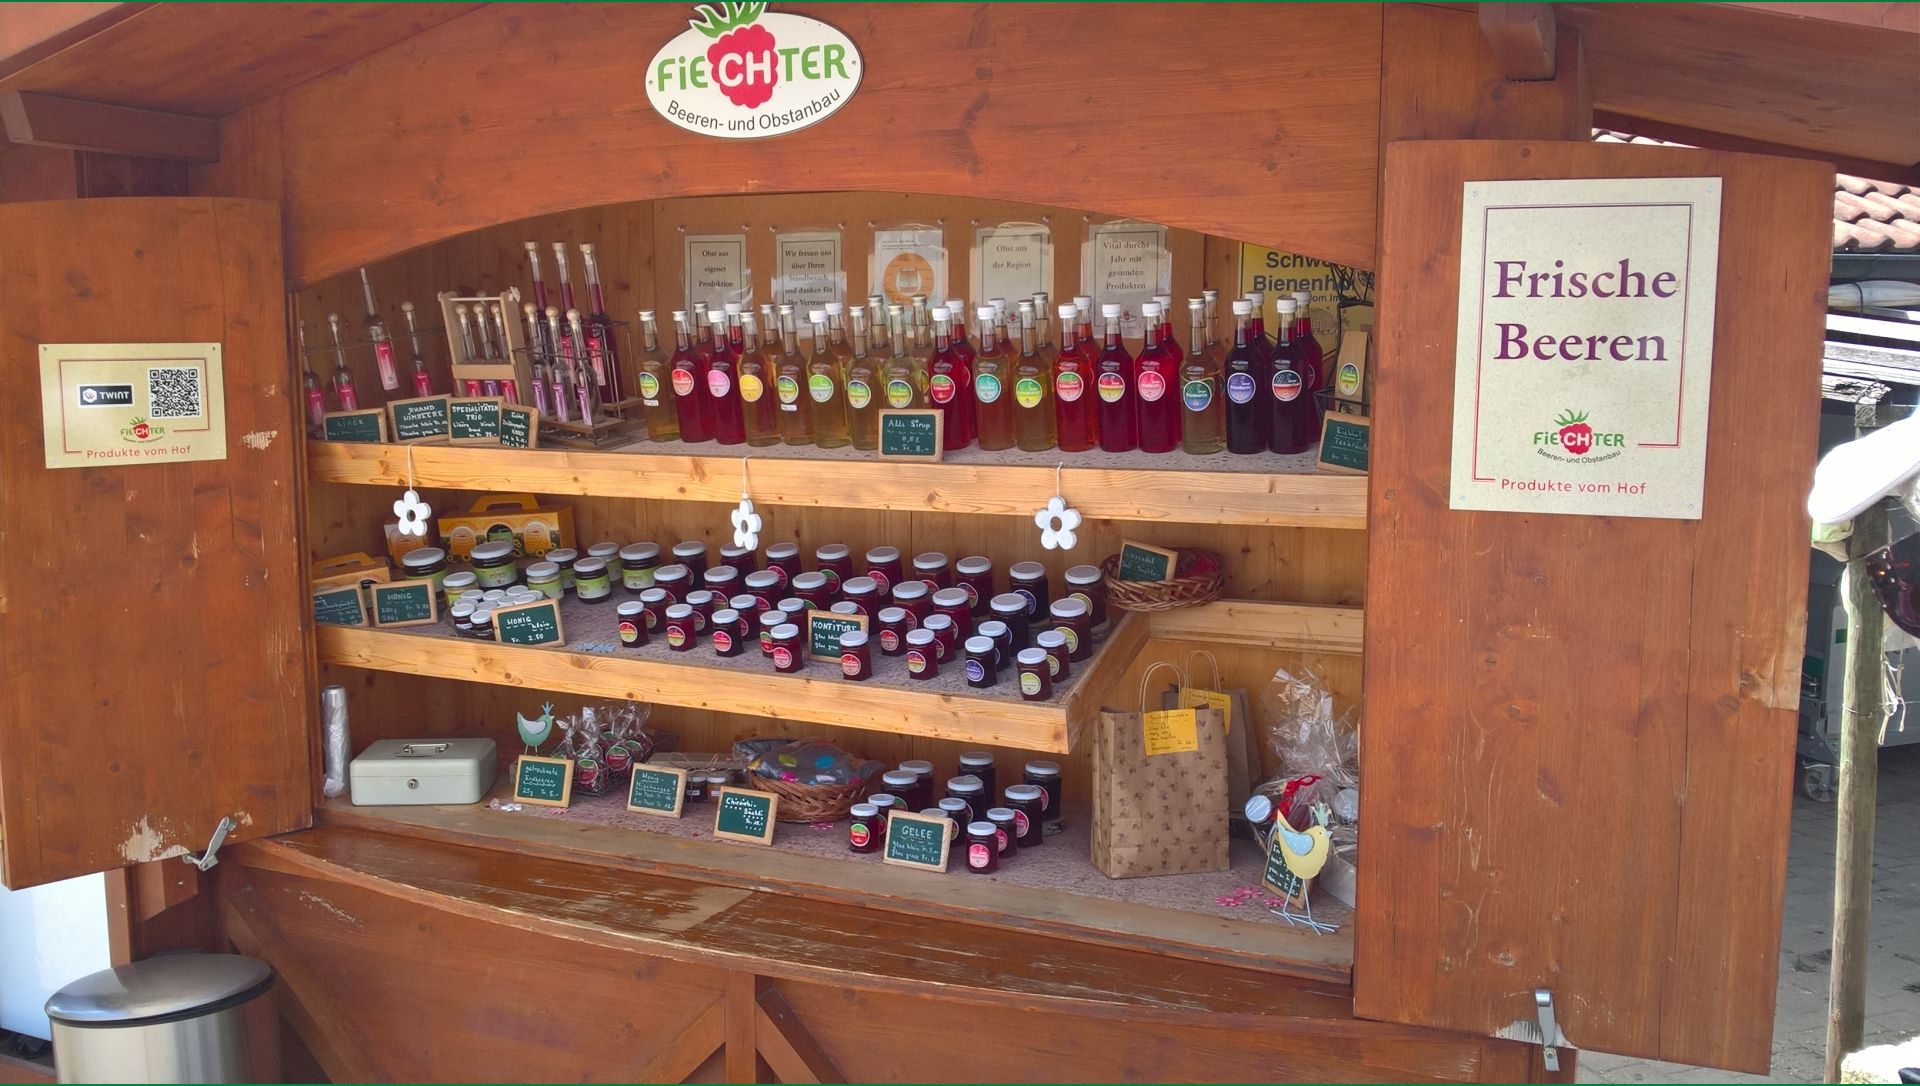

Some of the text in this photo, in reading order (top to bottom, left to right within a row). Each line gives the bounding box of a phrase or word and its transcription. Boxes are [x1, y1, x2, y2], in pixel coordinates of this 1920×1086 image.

[667, 88, 842, 131] Beeren- und Obstanbau
[1103, 242, 1122, 250] Vital
[1006, 261, 1032, 270] Region
[1254, 275, 1340, 291] Bienenh
[1492, 257, 1677, 299] Frische
[1493, 322, 1668, 362] Beeren
[98, 390, 130, 400] TWINT
[86, 445, 192, 458] Produkte vom Hof
[1566, 456, 1580, 464] und
[1580, 450, 1621, 464] Obstanbau
[1500, 478, 1647, 494] Produkte vom Hof
[902, 825, 933, 840] GELEE
